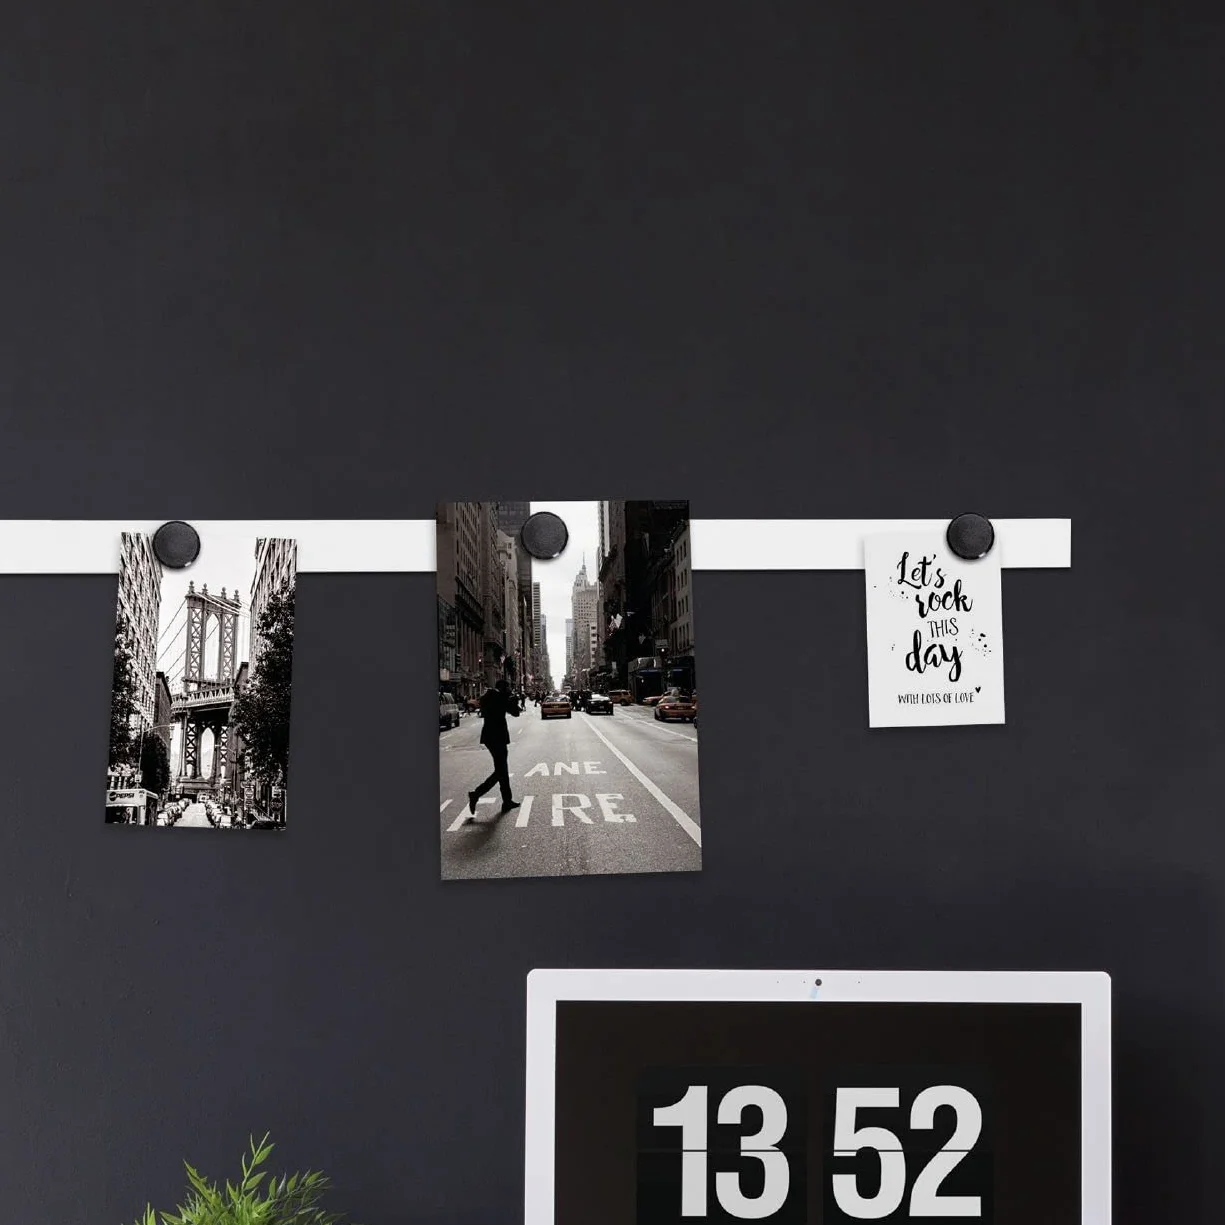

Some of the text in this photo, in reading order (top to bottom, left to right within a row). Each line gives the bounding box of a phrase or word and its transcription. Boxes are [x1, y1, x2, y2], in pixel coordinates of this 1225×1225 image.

[896, 551, 947, 590] Let's
[914, 578, 974, 619] rock
[926, 617, 960, 639] THIS
[905, 629, 964, 683] day
[897, 692, 975, 705] WITH LOTS OF LOVE
[510, 761, 608, 778] ANE
[653, 1085, 983, 1219] 13 52
